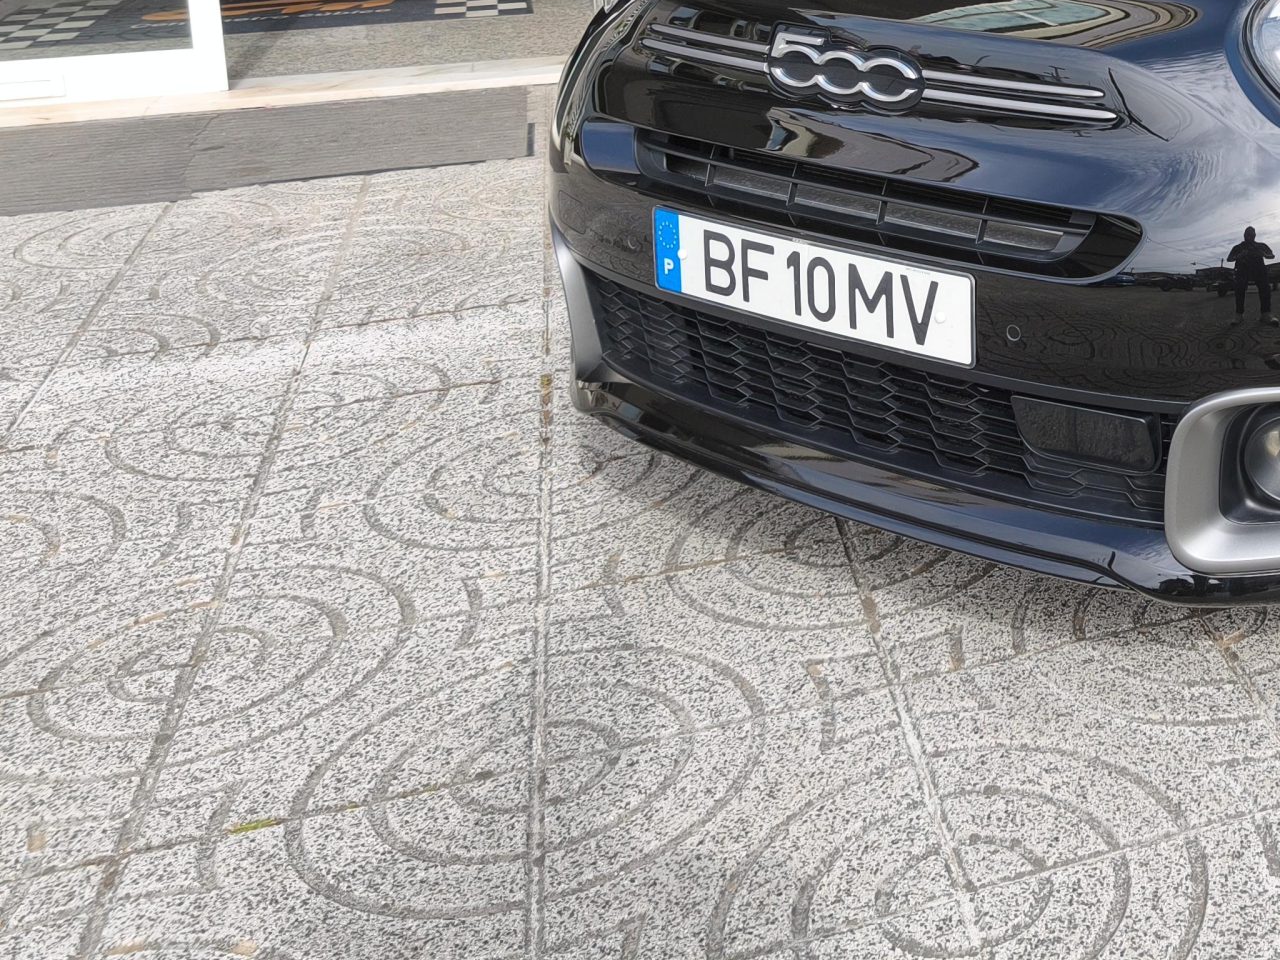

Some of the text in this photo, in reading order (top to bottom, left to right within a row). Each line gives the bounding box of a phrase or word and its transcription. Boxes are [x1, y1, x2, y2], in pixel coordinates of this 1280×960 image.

[770, 32, 918, 102] 500
[664, 258, 674, 275] P
[703, 229, 939, 346] BF 10 MV
